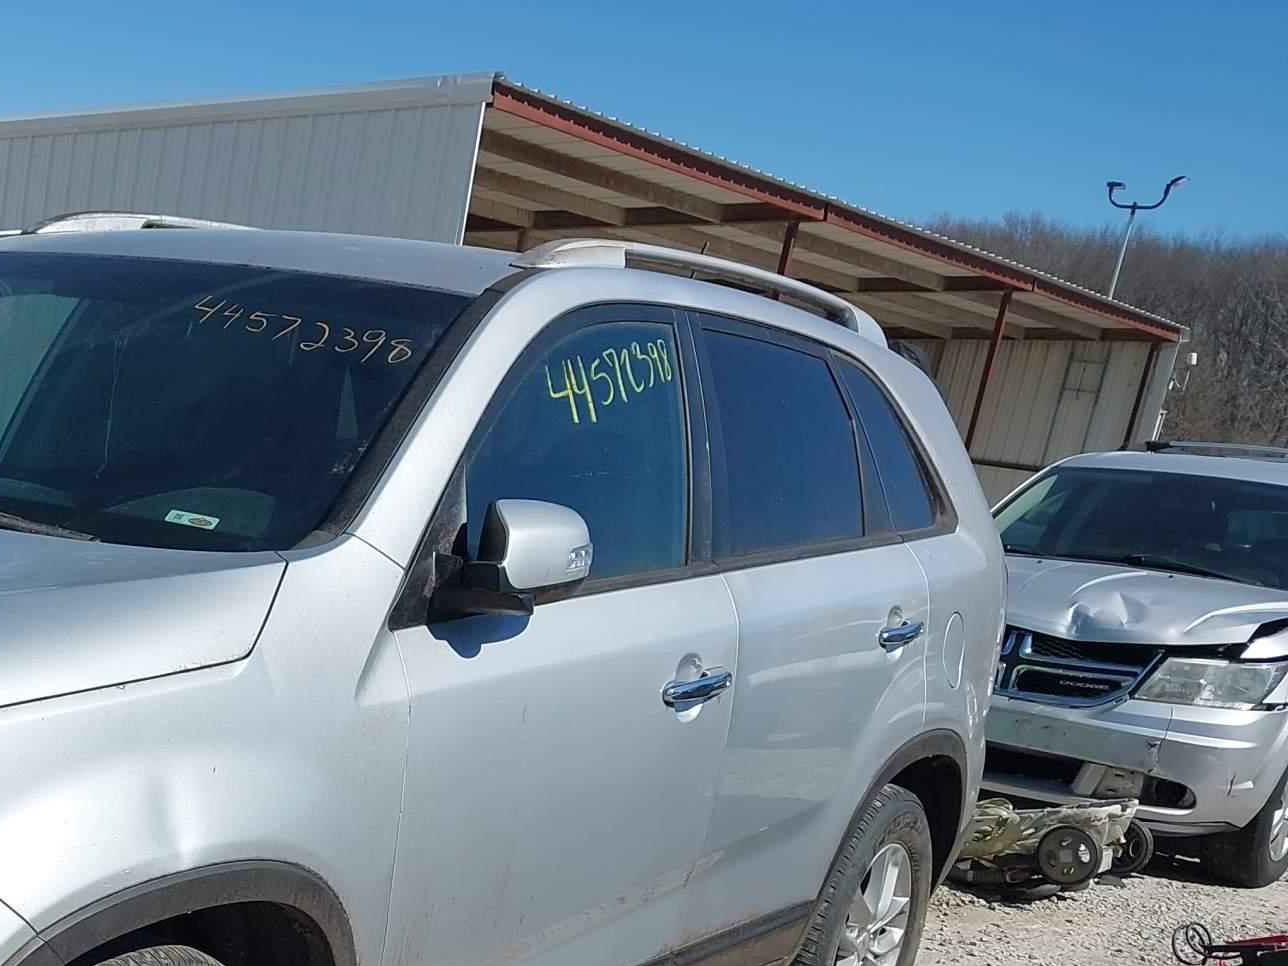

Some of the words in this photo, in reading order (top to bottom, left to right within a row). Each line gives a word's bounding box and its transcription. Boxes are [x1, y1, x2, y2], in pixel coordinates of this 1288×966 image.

[194, 295, 413, 364] 44572398
[544, 338, 673, 424] 44572398
[1059, 680, 1109, 690] DODGE
